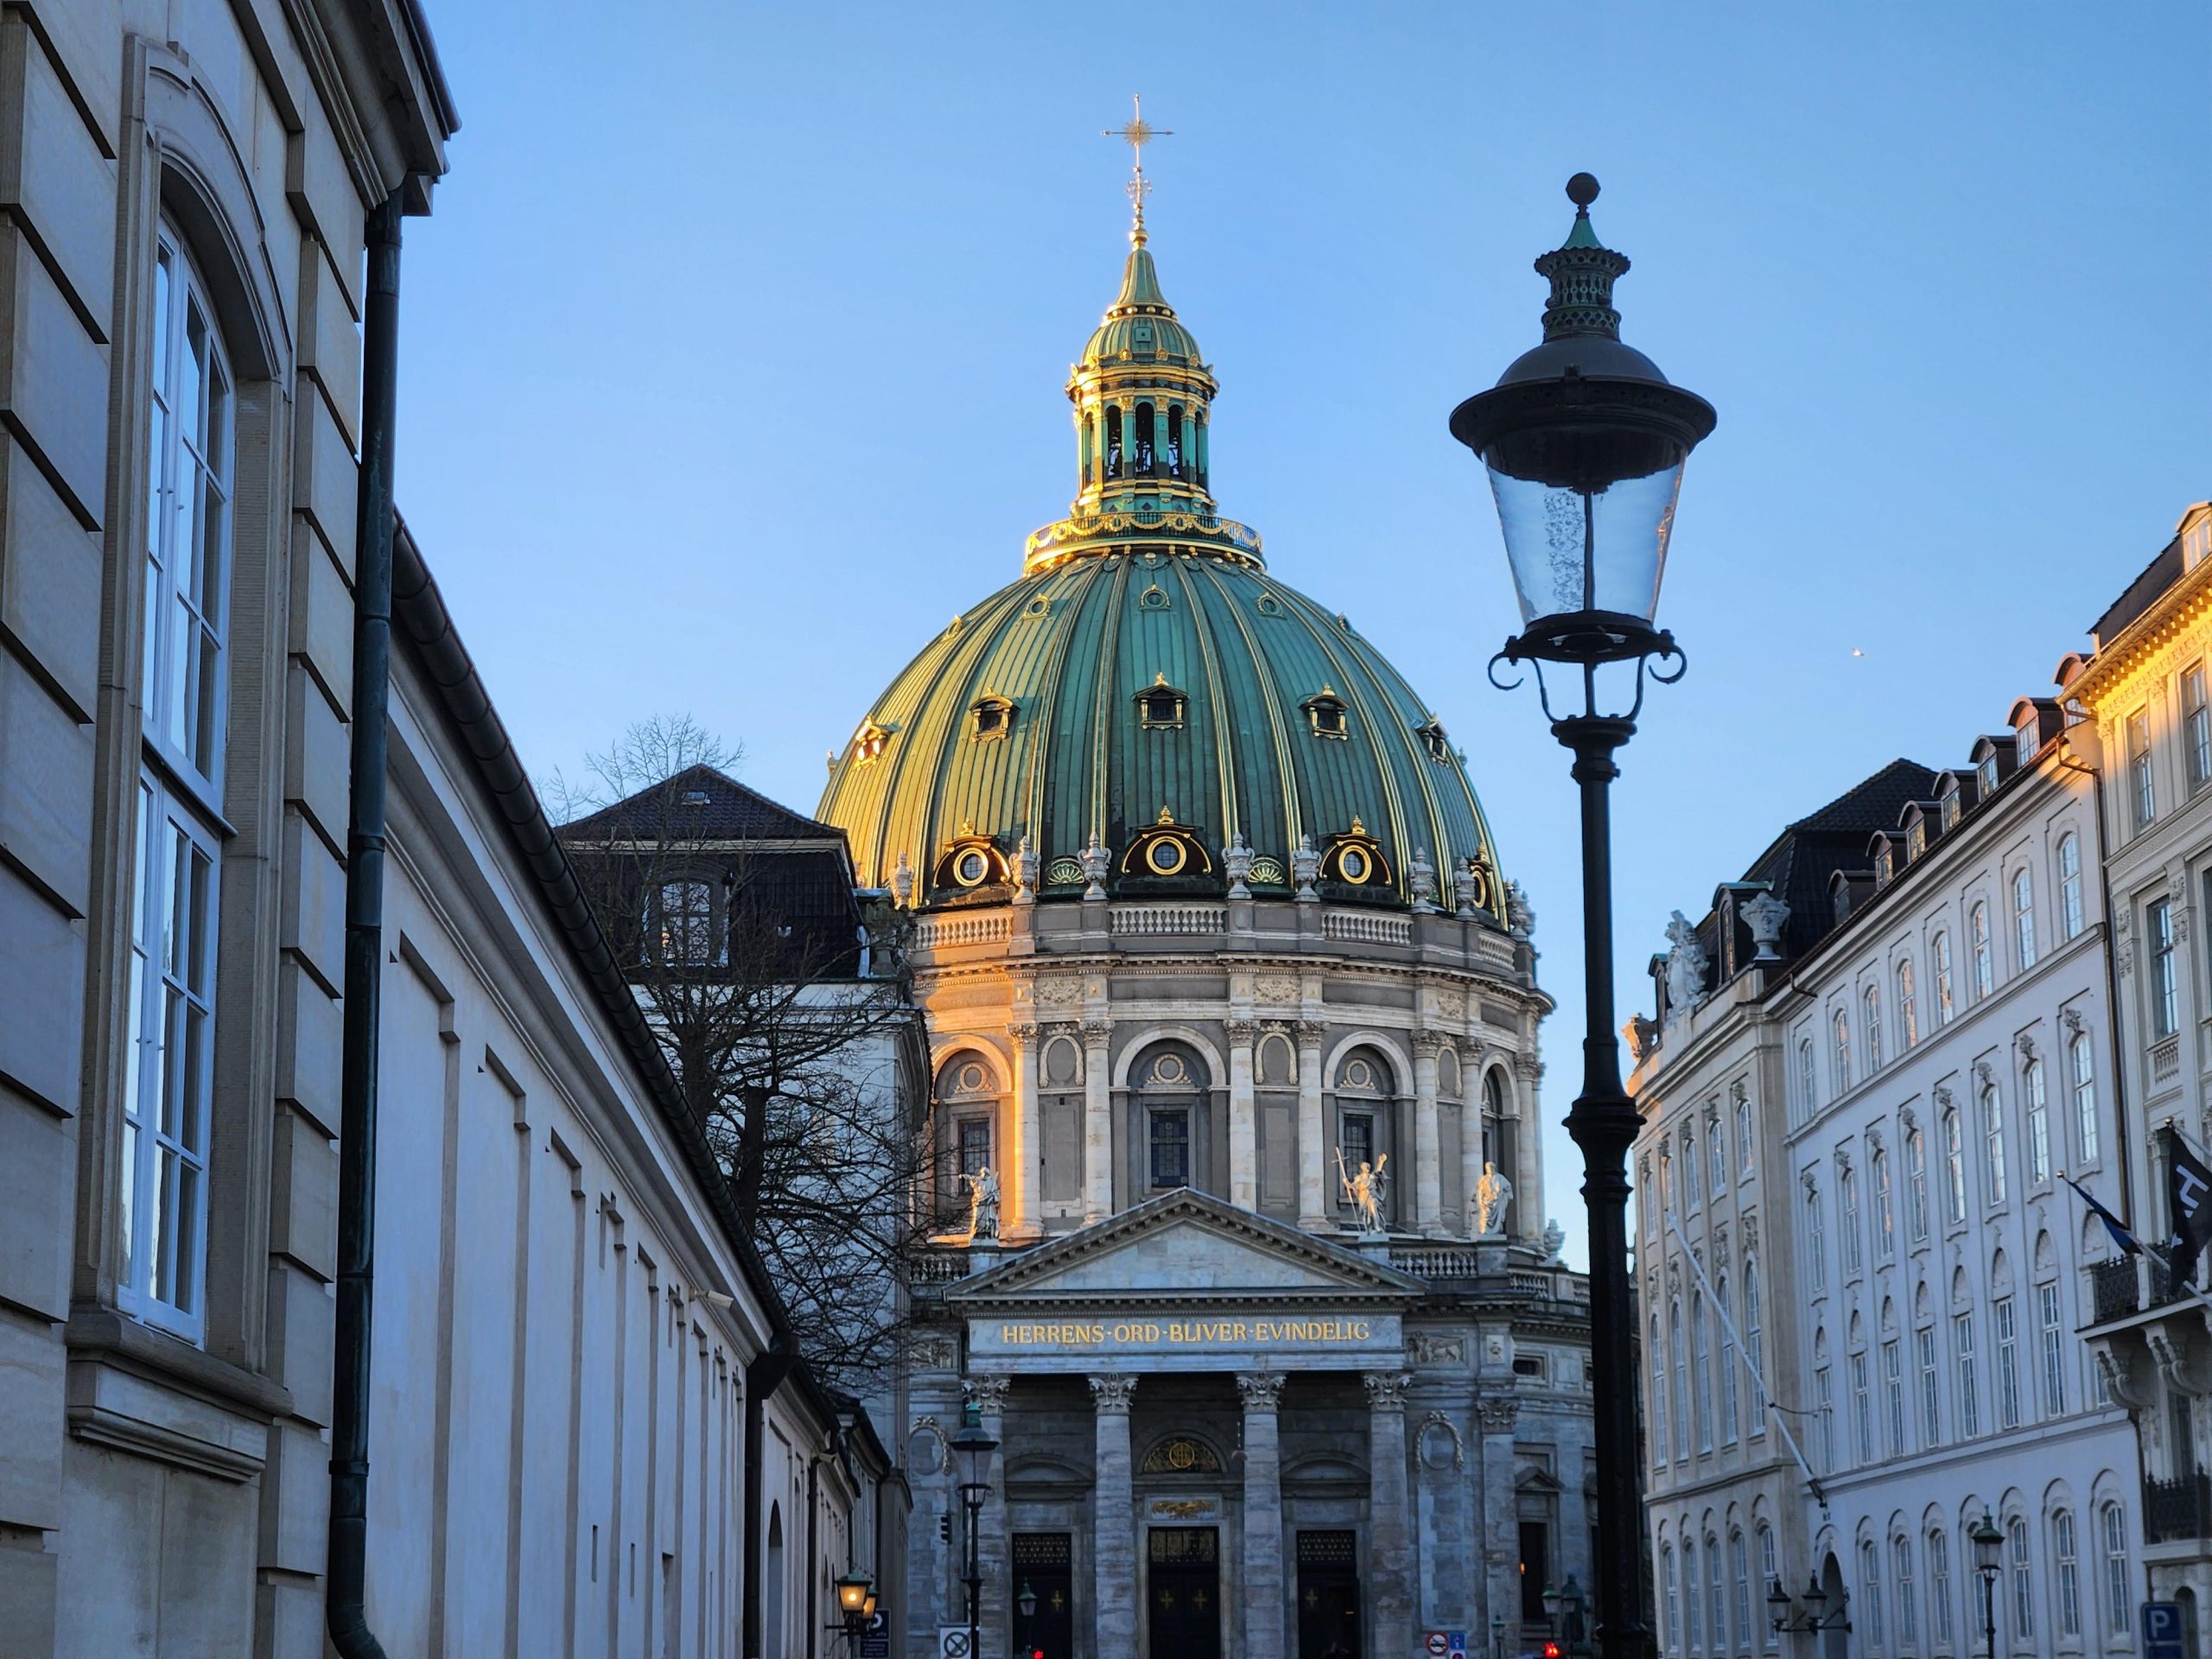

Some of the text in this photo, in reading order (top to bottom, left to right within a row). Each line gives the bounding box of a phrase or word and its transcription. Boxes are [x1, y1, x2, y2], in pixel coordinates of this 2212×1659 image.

[1002, 1322, 1370, 1344] HERRENS ORD BLIVER EVINDELIG
[2150, 1610, 2170, 1638] P
